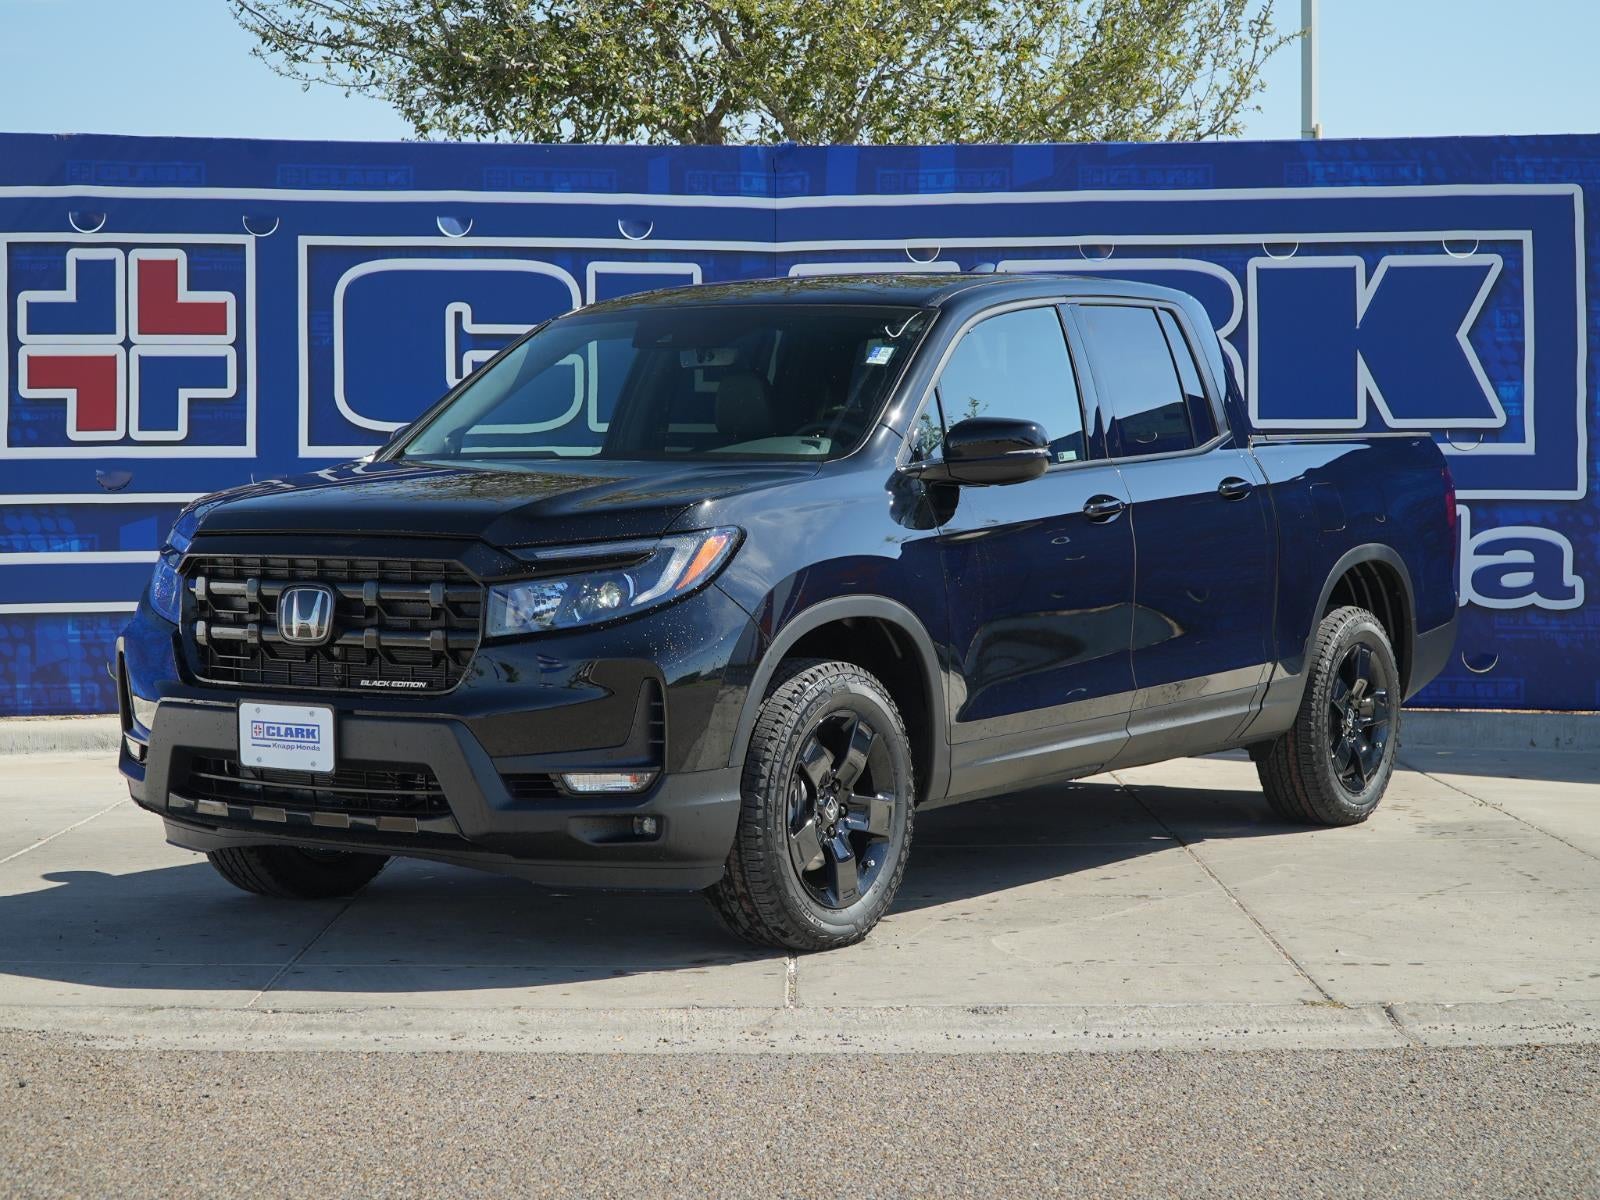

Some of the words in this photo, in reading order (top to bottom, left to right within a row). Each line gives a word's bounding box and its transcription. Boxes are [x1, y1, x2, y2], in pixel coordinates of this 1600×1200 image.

[360, 679, 390, 688] BLACK
[391, 681, 427, 689] EDITION
[266, 726, 317, 739] CLARK
[272, 742, 296, 751] Knapp
[296, 744, 321, 752] Honda
